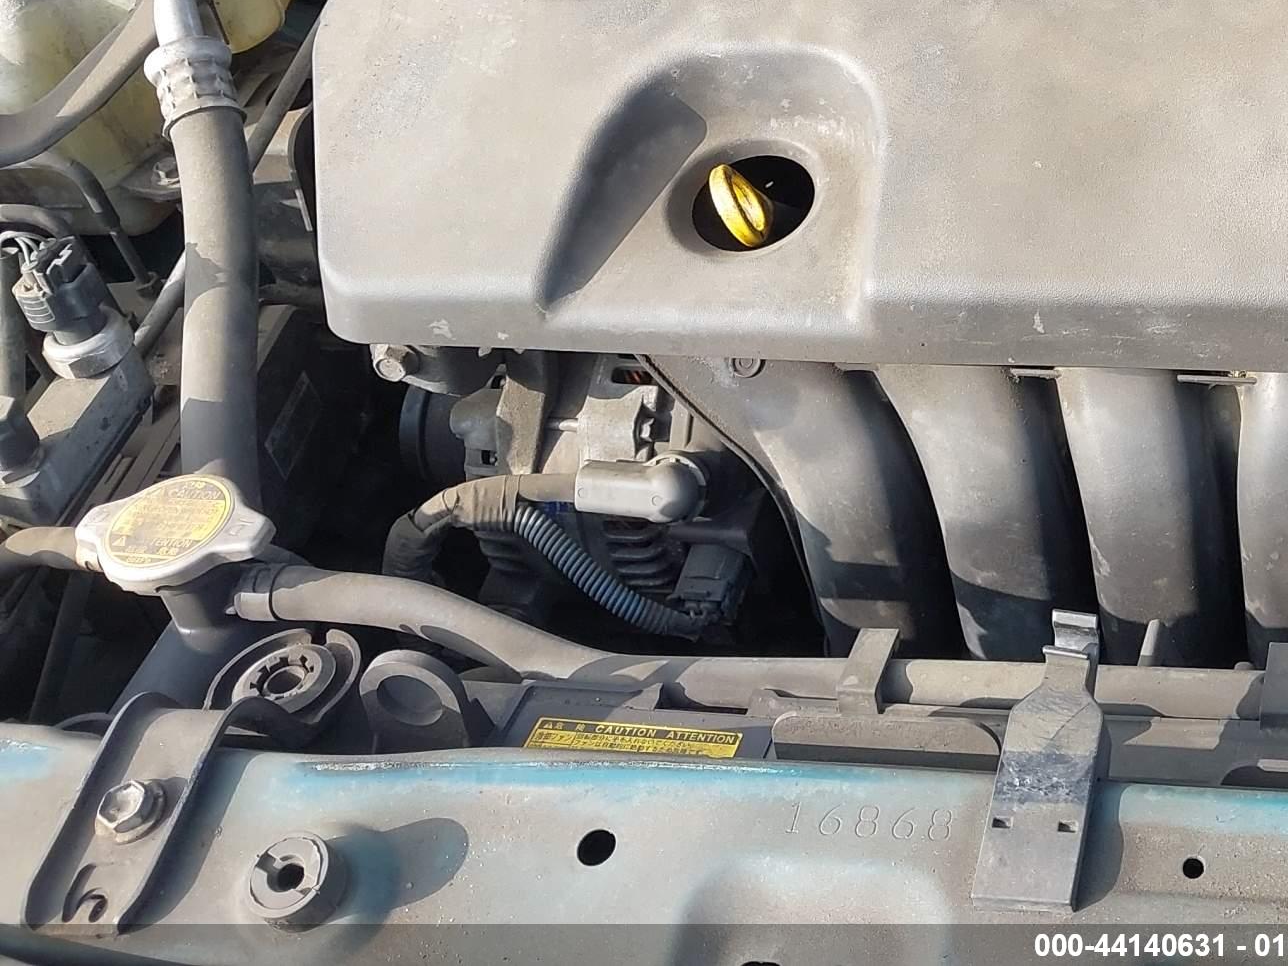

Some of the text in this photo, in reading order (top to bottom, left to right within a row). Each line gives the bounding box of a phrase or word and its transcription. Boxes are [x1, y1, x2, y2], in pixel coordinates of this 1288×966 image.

[167, 488, 221, 500] CAUTION
[594, 724, 657, 738] CAUTION
[666, 730, 736, 744] ATTENTION
[785, 801, 953, 841] 16868
